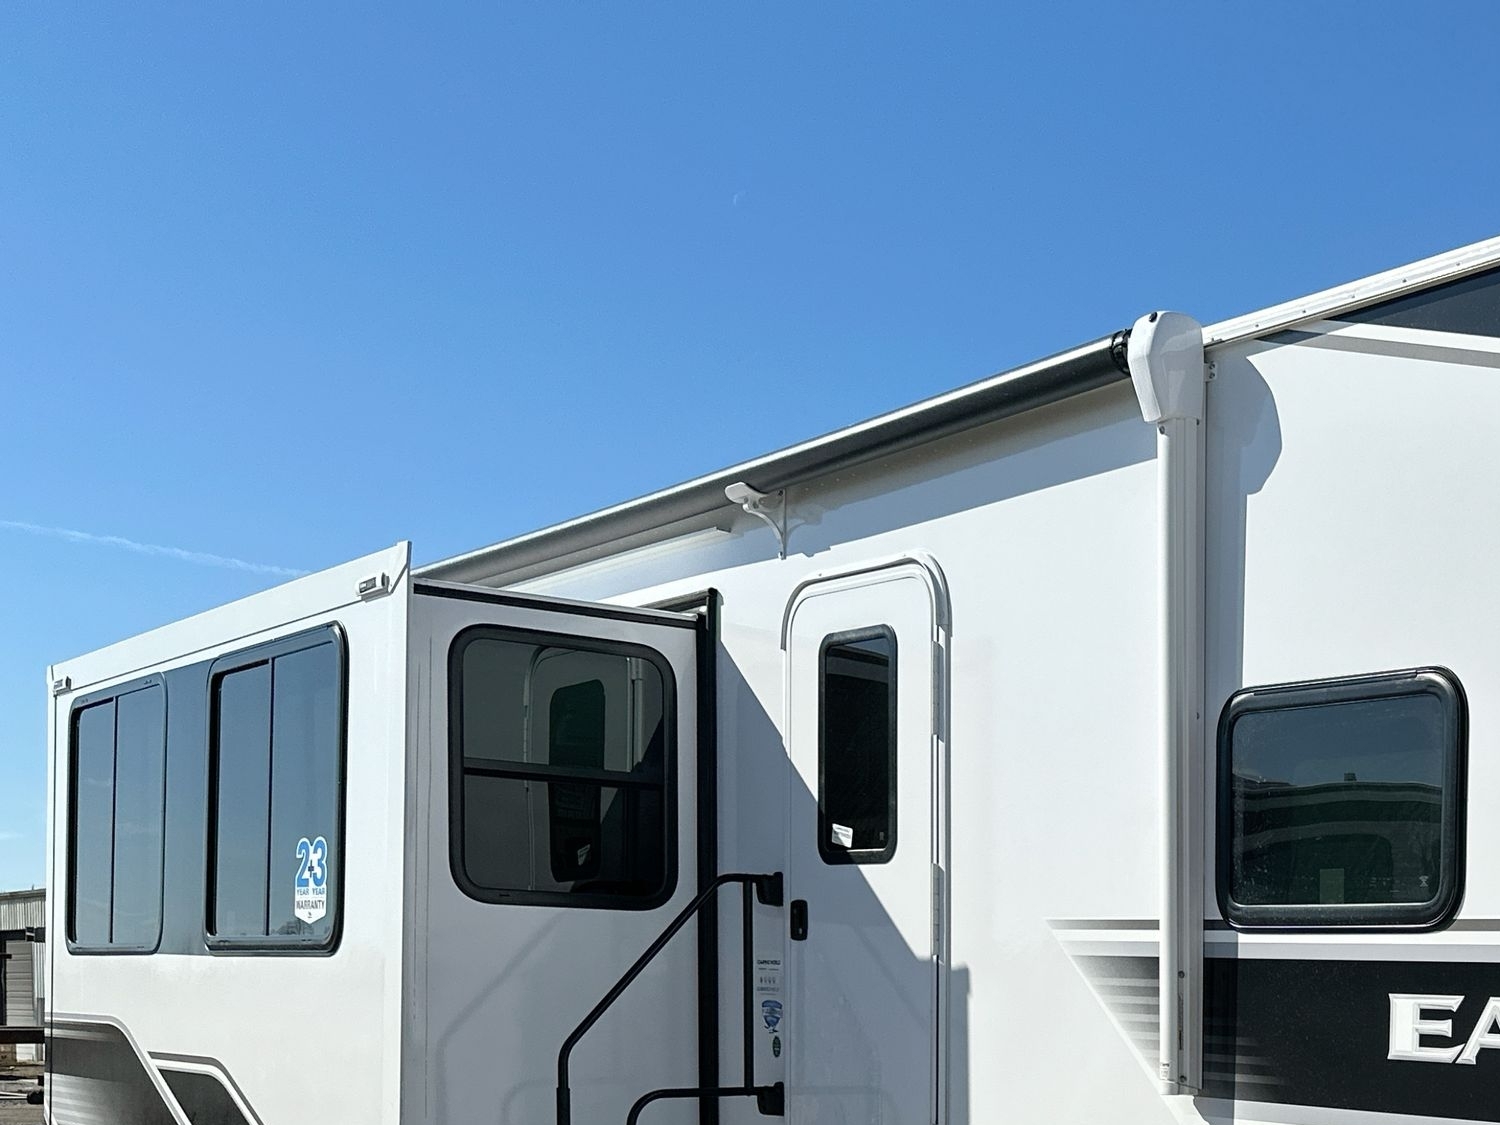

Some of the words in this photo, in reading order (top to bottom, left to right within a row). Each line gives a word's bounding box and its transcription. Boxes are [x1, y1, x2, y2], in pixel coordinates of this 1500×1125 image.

[297, 888, 310, 896] YEAR
[312, 887, 326, 895] YEAR
[296, 900, 325, 910] WARRANTY
